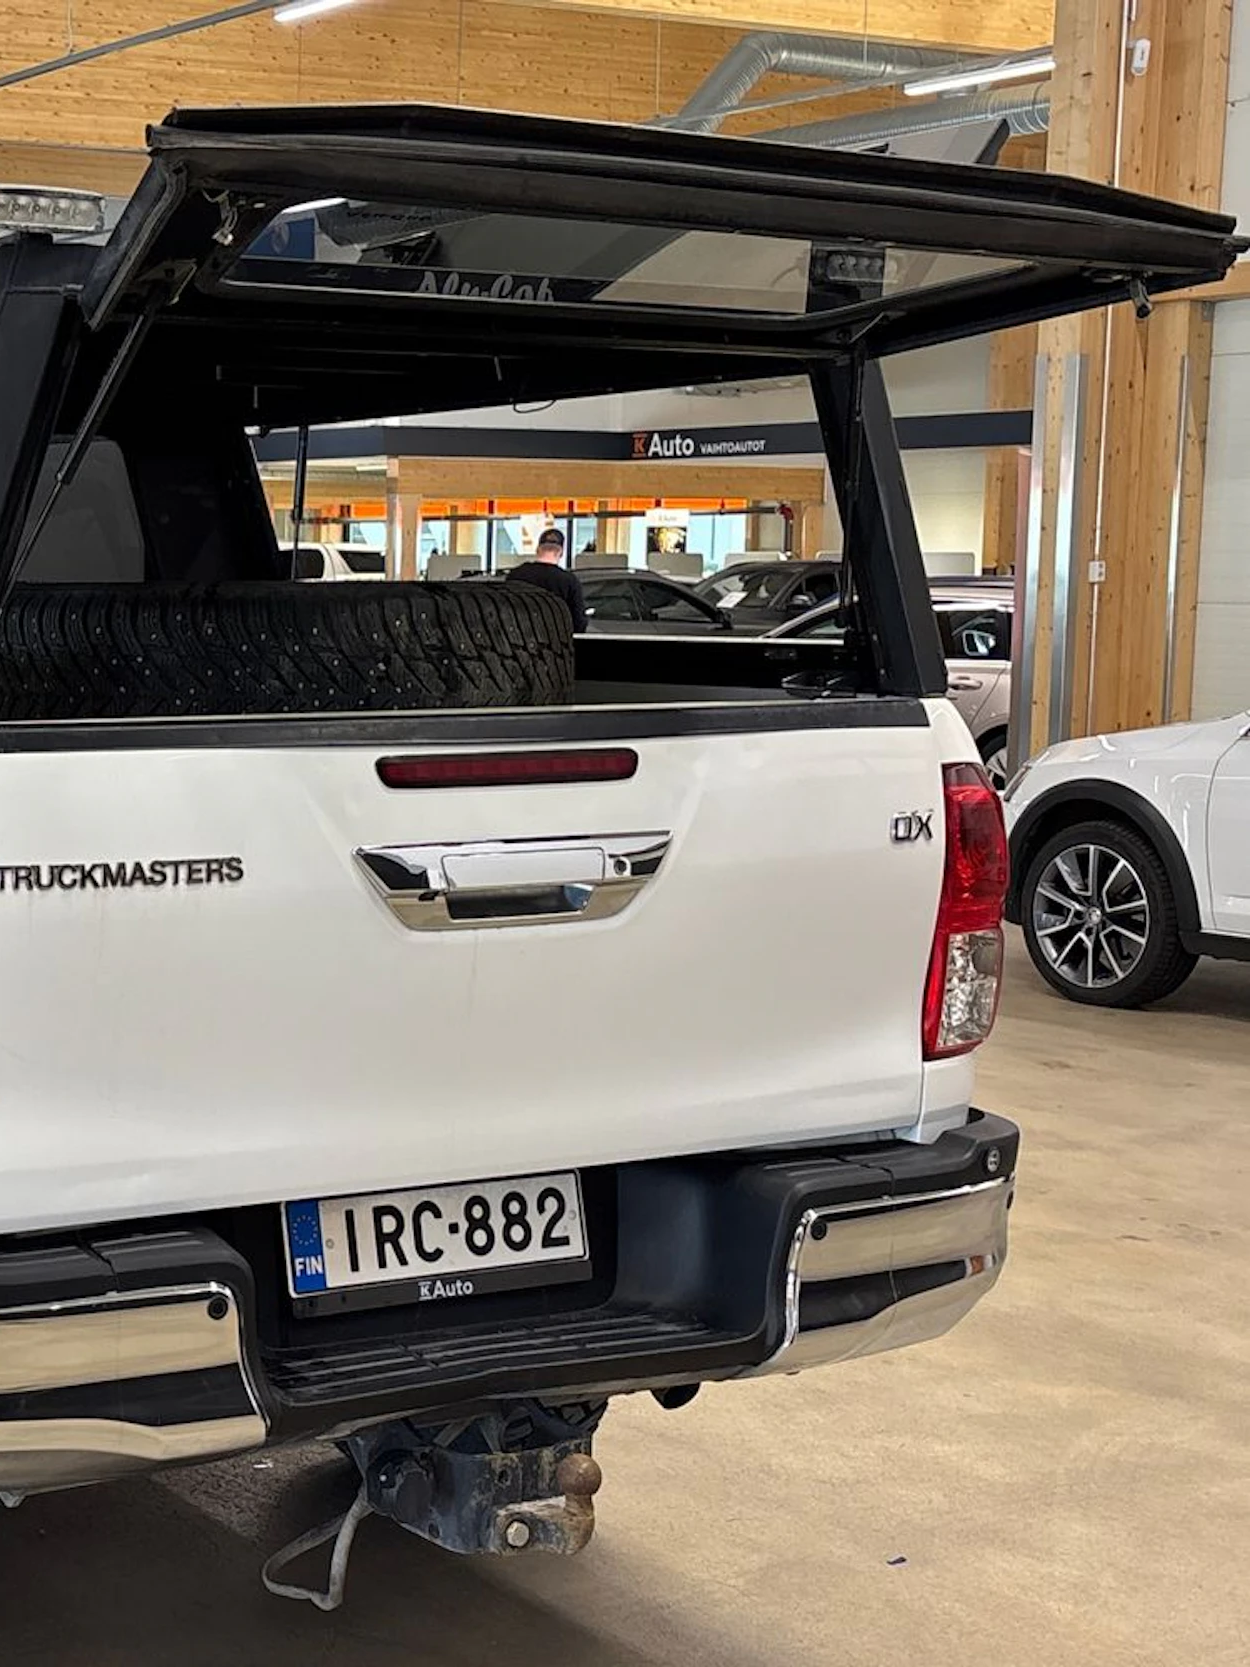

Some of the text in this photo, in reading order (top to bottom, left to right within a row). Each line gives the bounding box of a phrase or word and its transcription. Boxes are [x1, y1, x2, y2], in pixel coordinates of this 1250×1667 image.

[648, 432, 695, 457] Auto
[700, 440, 766, 455] VAIHTOAUTOT
[294, 1255, 324, 1277] FIN
